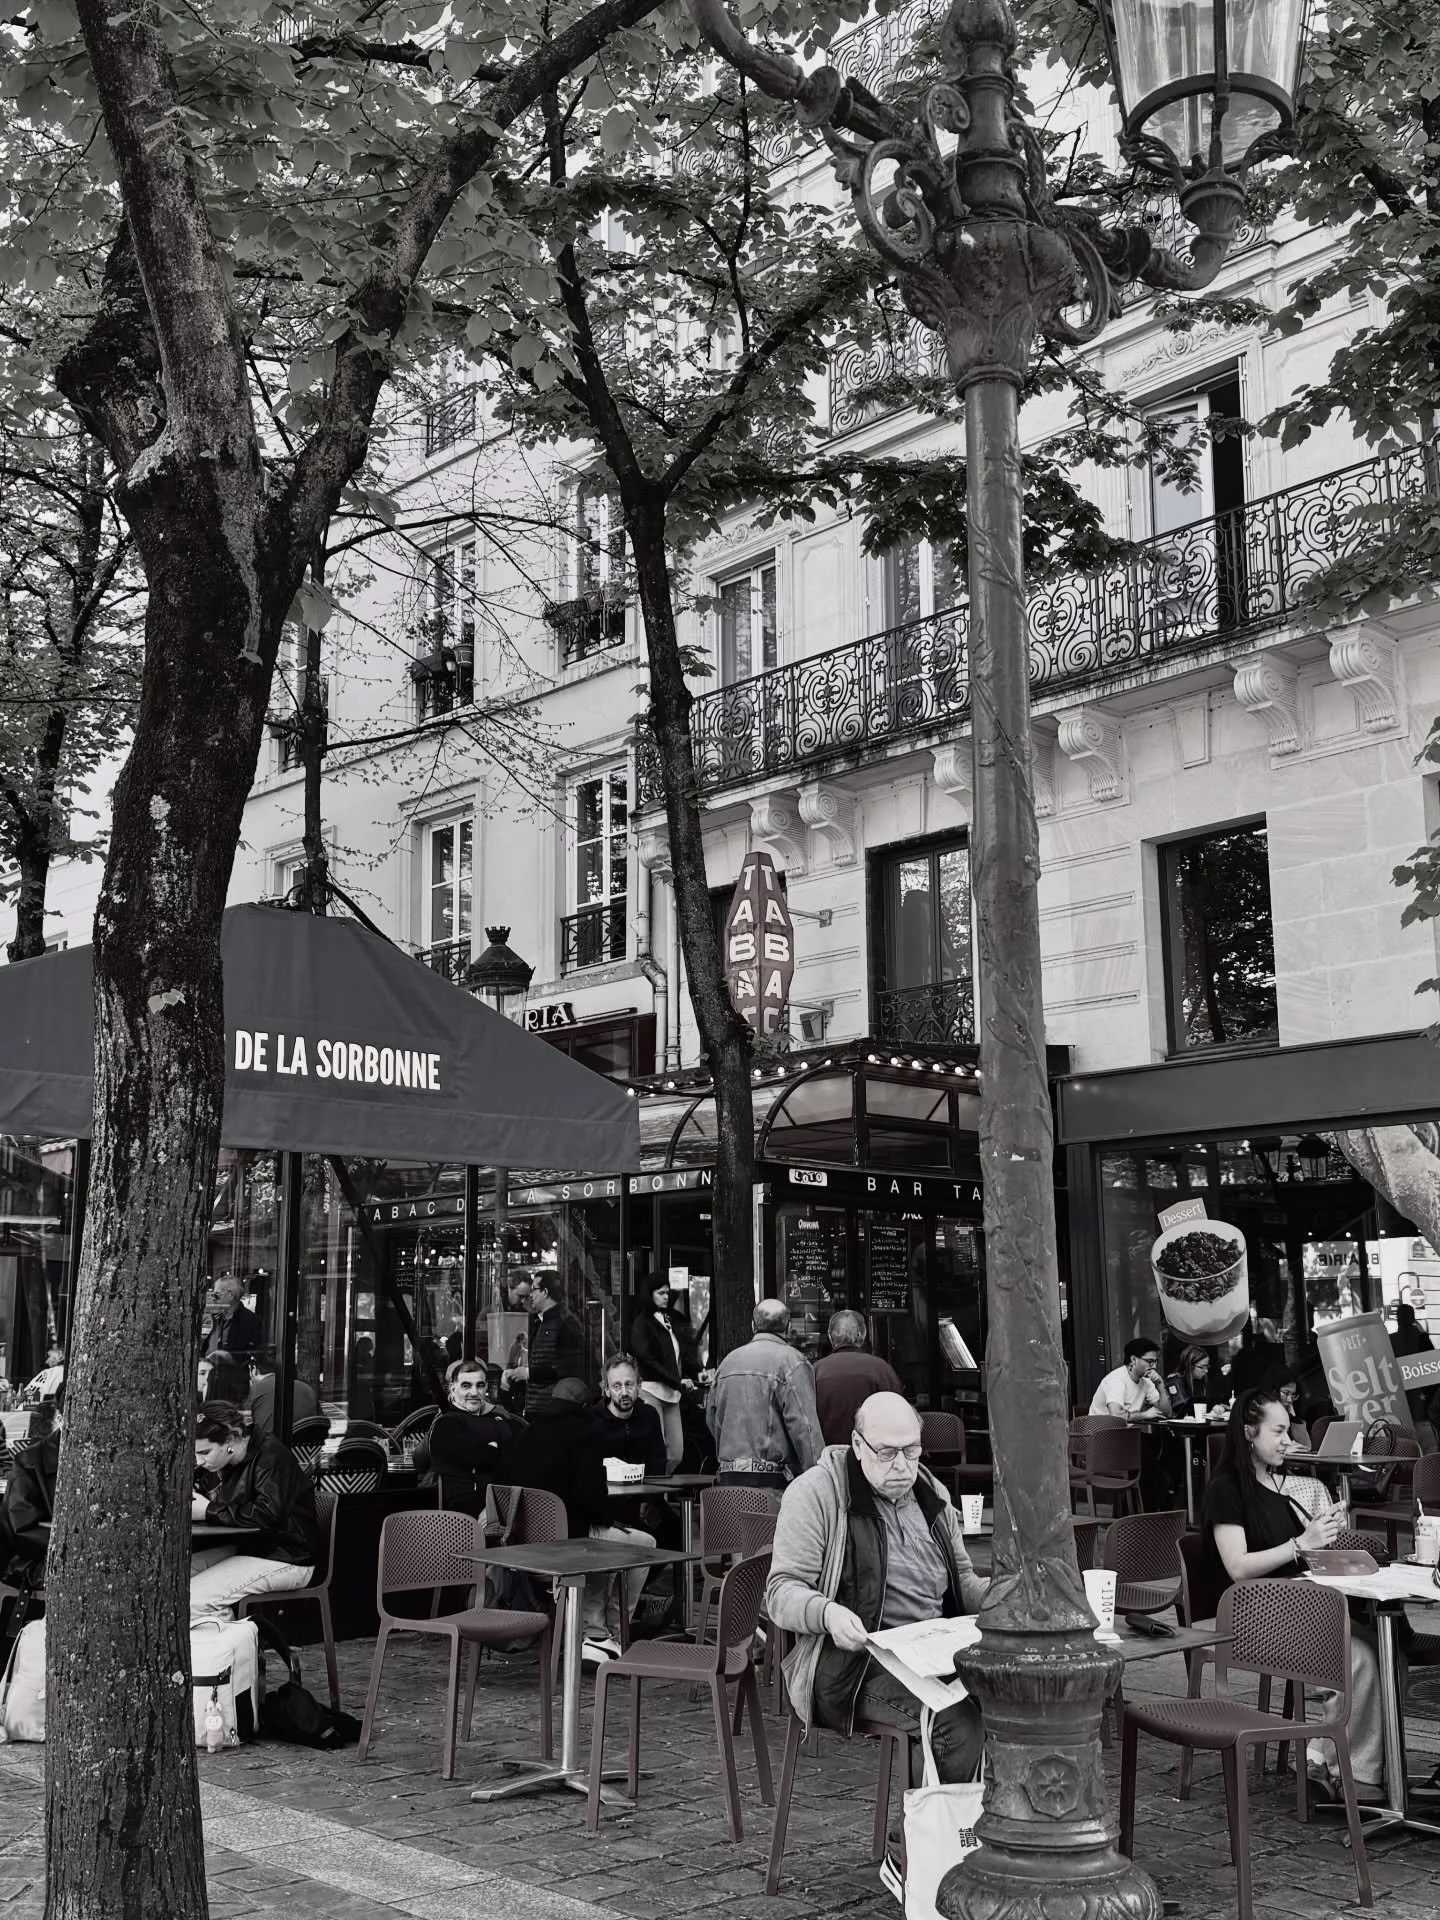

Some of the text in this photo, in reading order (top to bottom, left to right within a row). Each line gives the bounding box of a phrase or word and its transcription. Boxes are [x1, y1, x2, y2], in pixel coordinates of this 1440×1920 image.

[760, 864, 791, 1034] TABAC
[523, 1002, 577, 1032] RIA
[235, 1030, 441, 1090] DE LA SORBONNE
[373, 1201, 436, 1222] ABAC
[508, 1191, 537, 1207] LA
[562, 1170, 712, 1200] SORBONN
[794, 1170, 824, 1184] LOTO
[867, 1176, 923, 1197] BAR
[1162, 1203, 1203, 1228] Dessert
[1328, 1354, 1399, 1405] Selt
